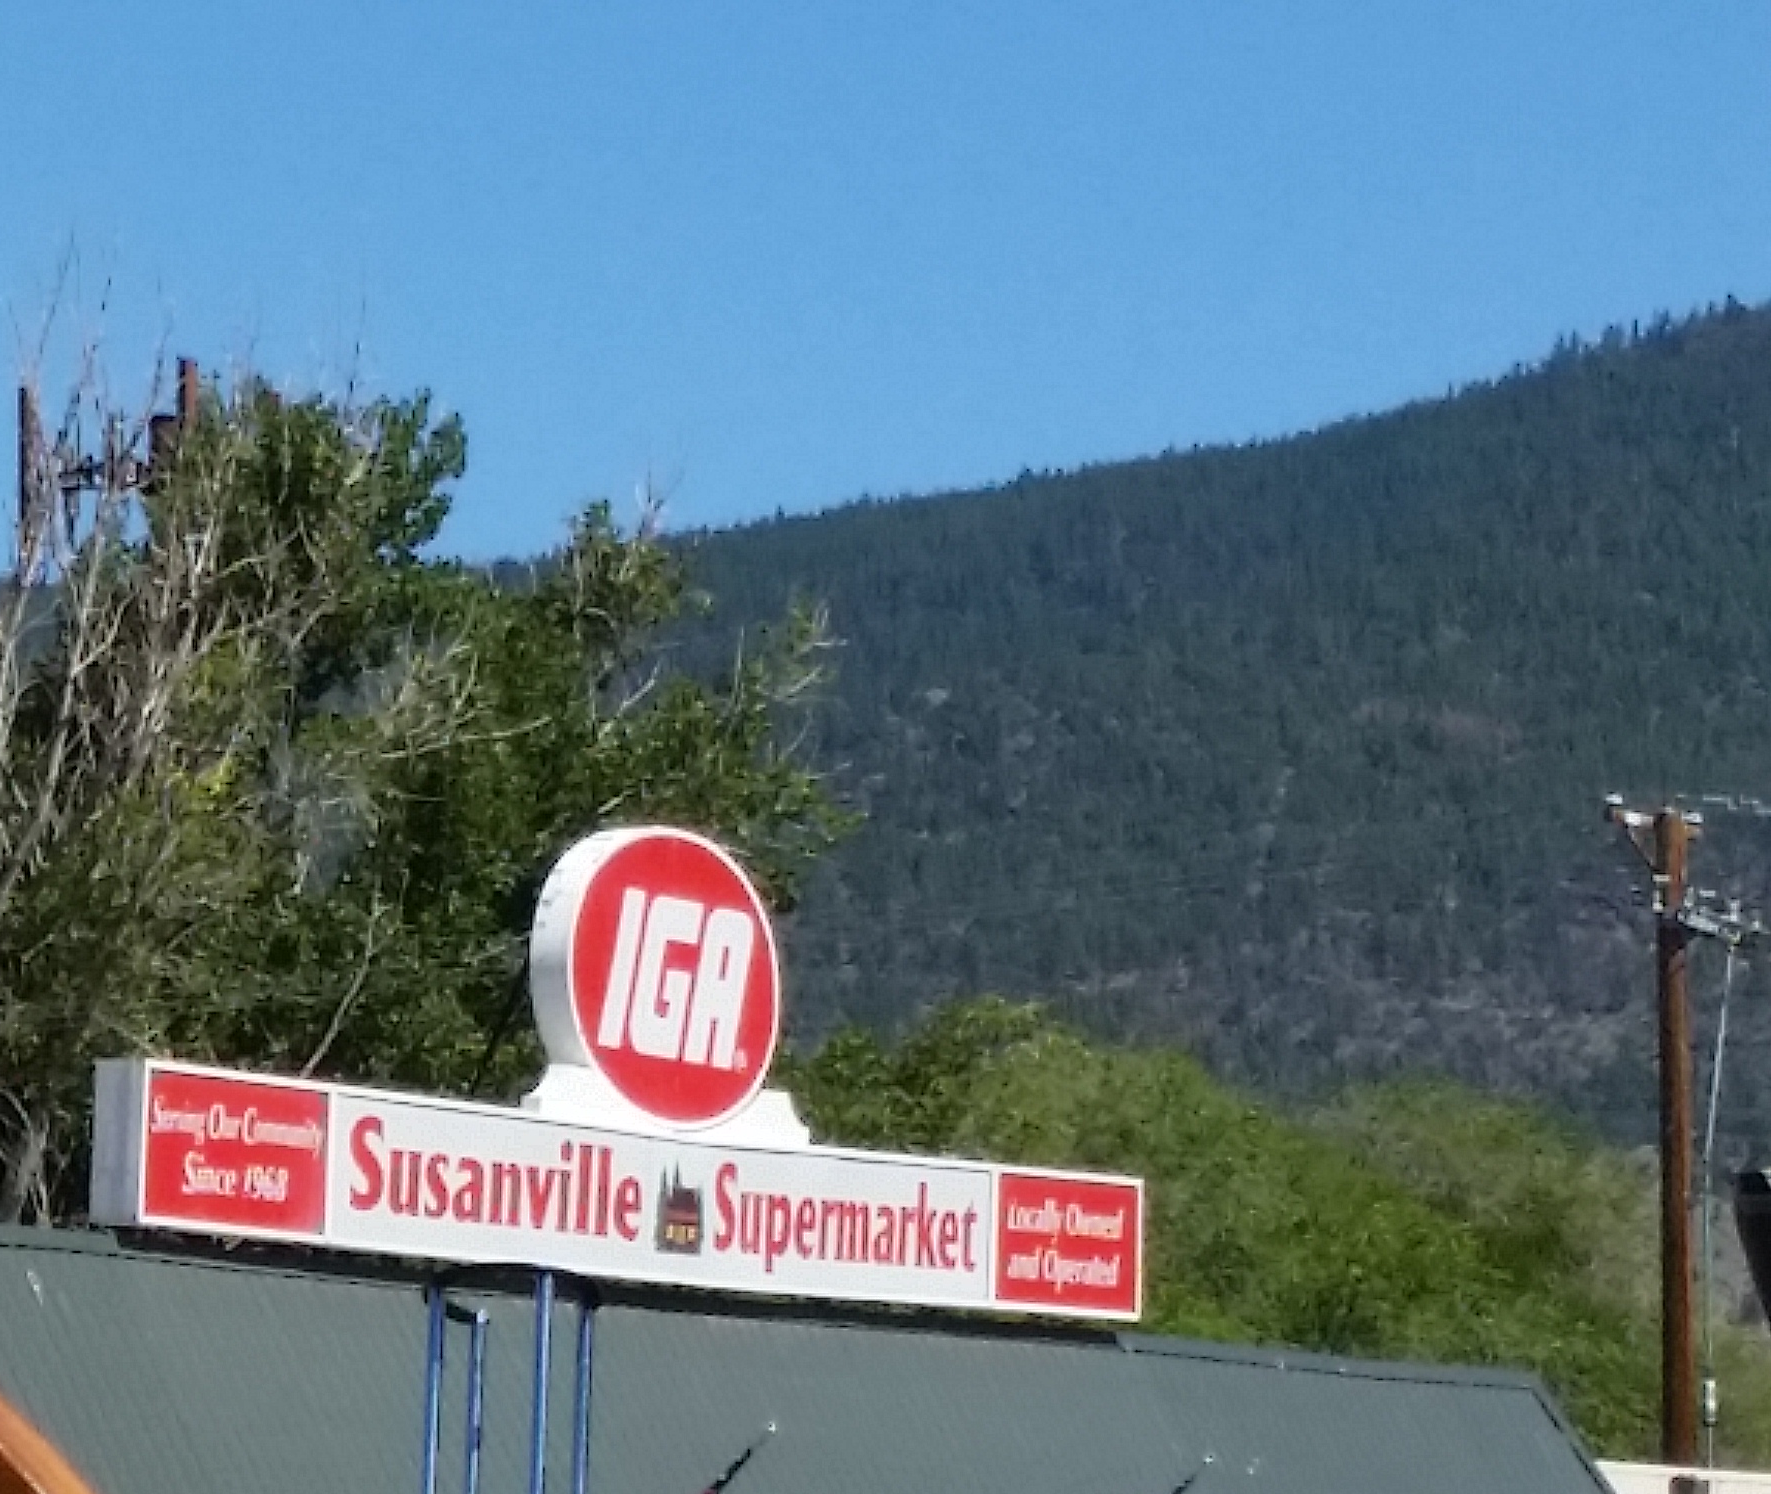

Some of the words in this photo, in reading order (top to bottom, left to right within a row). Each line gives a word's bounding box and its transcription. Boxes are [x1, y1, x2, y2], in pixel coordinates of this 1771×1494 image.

[598, 887, 754, 1070] IGA
[150, 1096, 205, 1146] Serving
[210, 1104, 242, 1140] Our
[244, 1107, 323, 1160] Community
[182, 1151, 237, 1195] Since
[242, 1165, 289, 1203] 1968
[350, 1115, 643, 1242] Susanville
[714, 1162, 978, 1274] Supermarket
[1008, 1197, 1062, 1245] Locally
[1066, 1203, 1125, 1241] Owned
[1008, 1247, 1041, 1280] and
[1045, 1250, 1121, 1295] Operated
